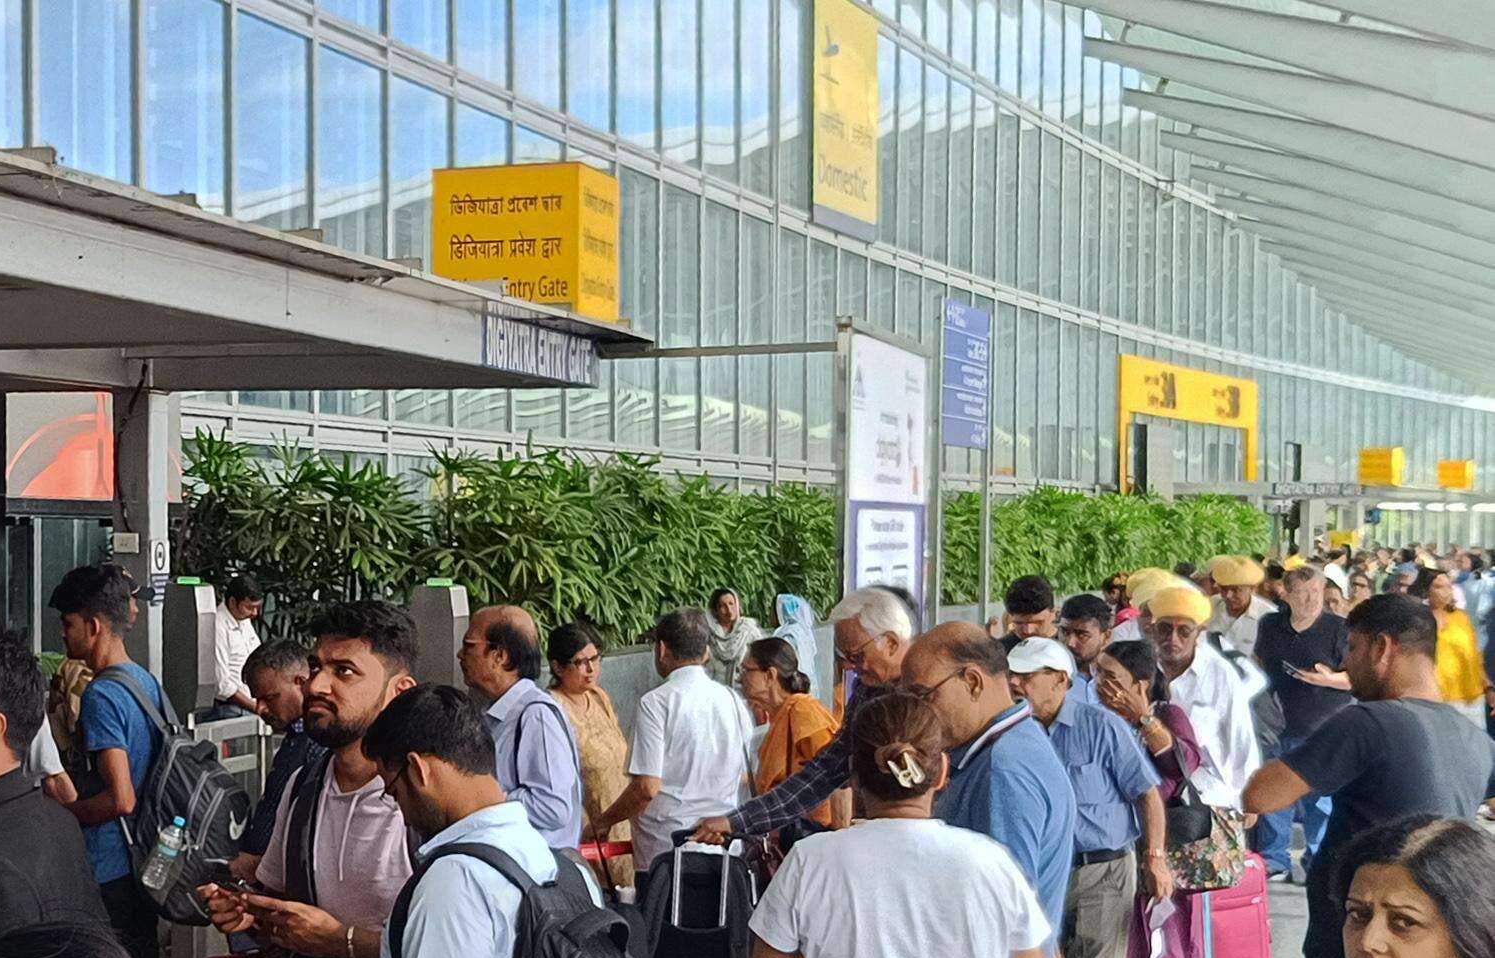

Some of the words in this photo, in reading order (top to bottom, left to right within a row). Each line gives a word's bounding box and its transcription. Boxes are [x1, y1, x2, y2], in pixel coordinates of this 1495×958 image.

[450, 234, 504, 260] डिजियात्रा
[508, 231, 537, 258] प्रवेश
[541, 237, 562, 259] द्वार
[538, 275, 568, 297] Gate
